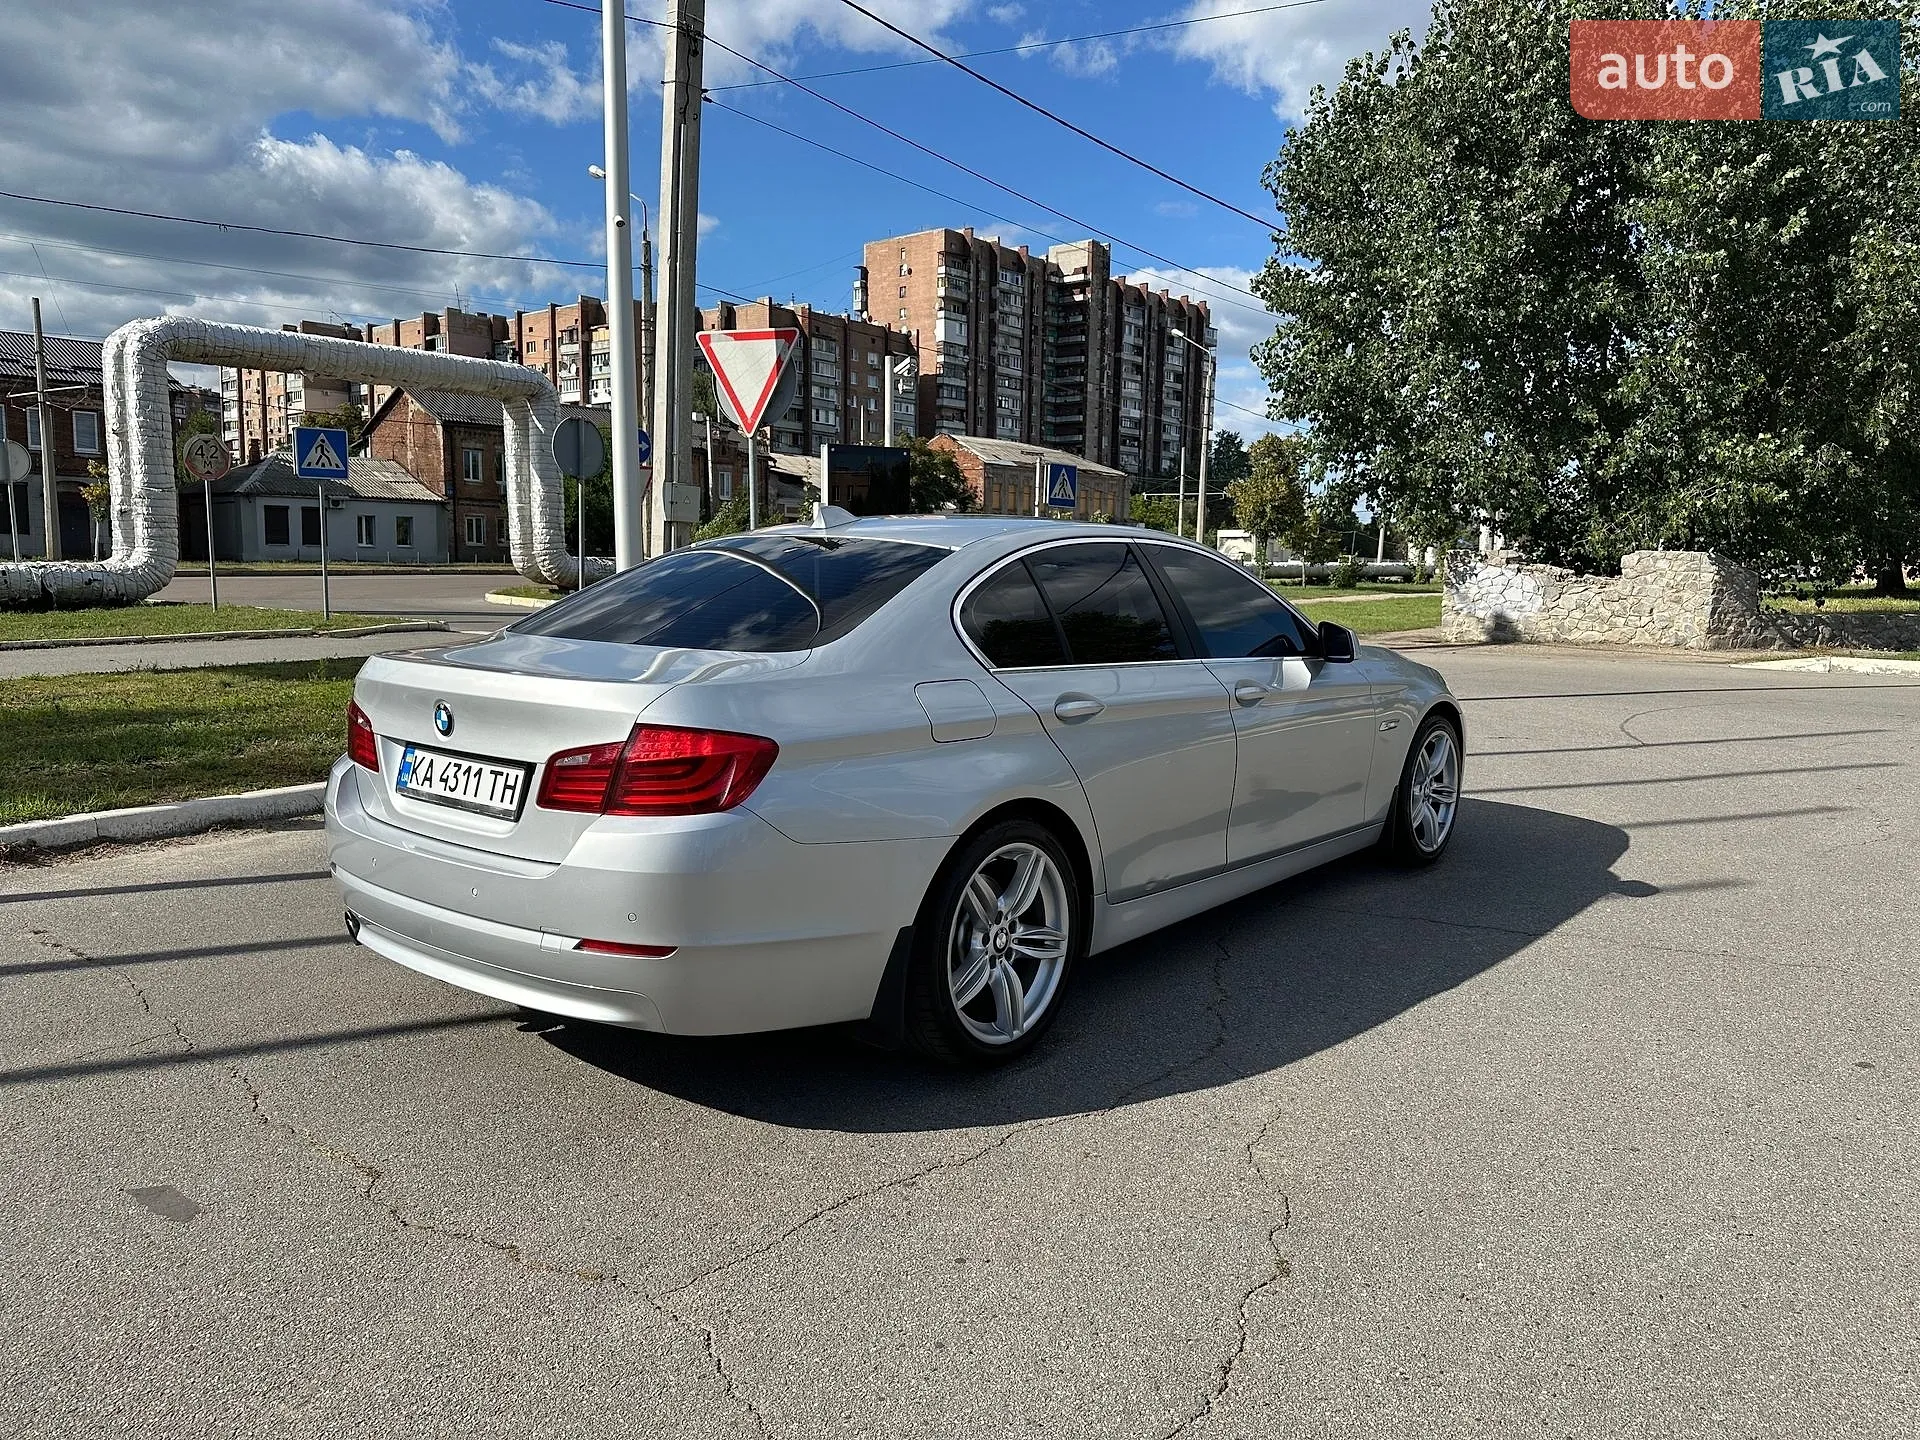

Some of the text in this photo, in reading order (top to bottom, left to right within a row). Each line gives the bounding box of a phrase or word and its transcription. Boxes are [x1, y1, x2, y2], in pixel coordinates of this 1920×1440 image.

[409, 755, 519, 805] KA 4311 TH
